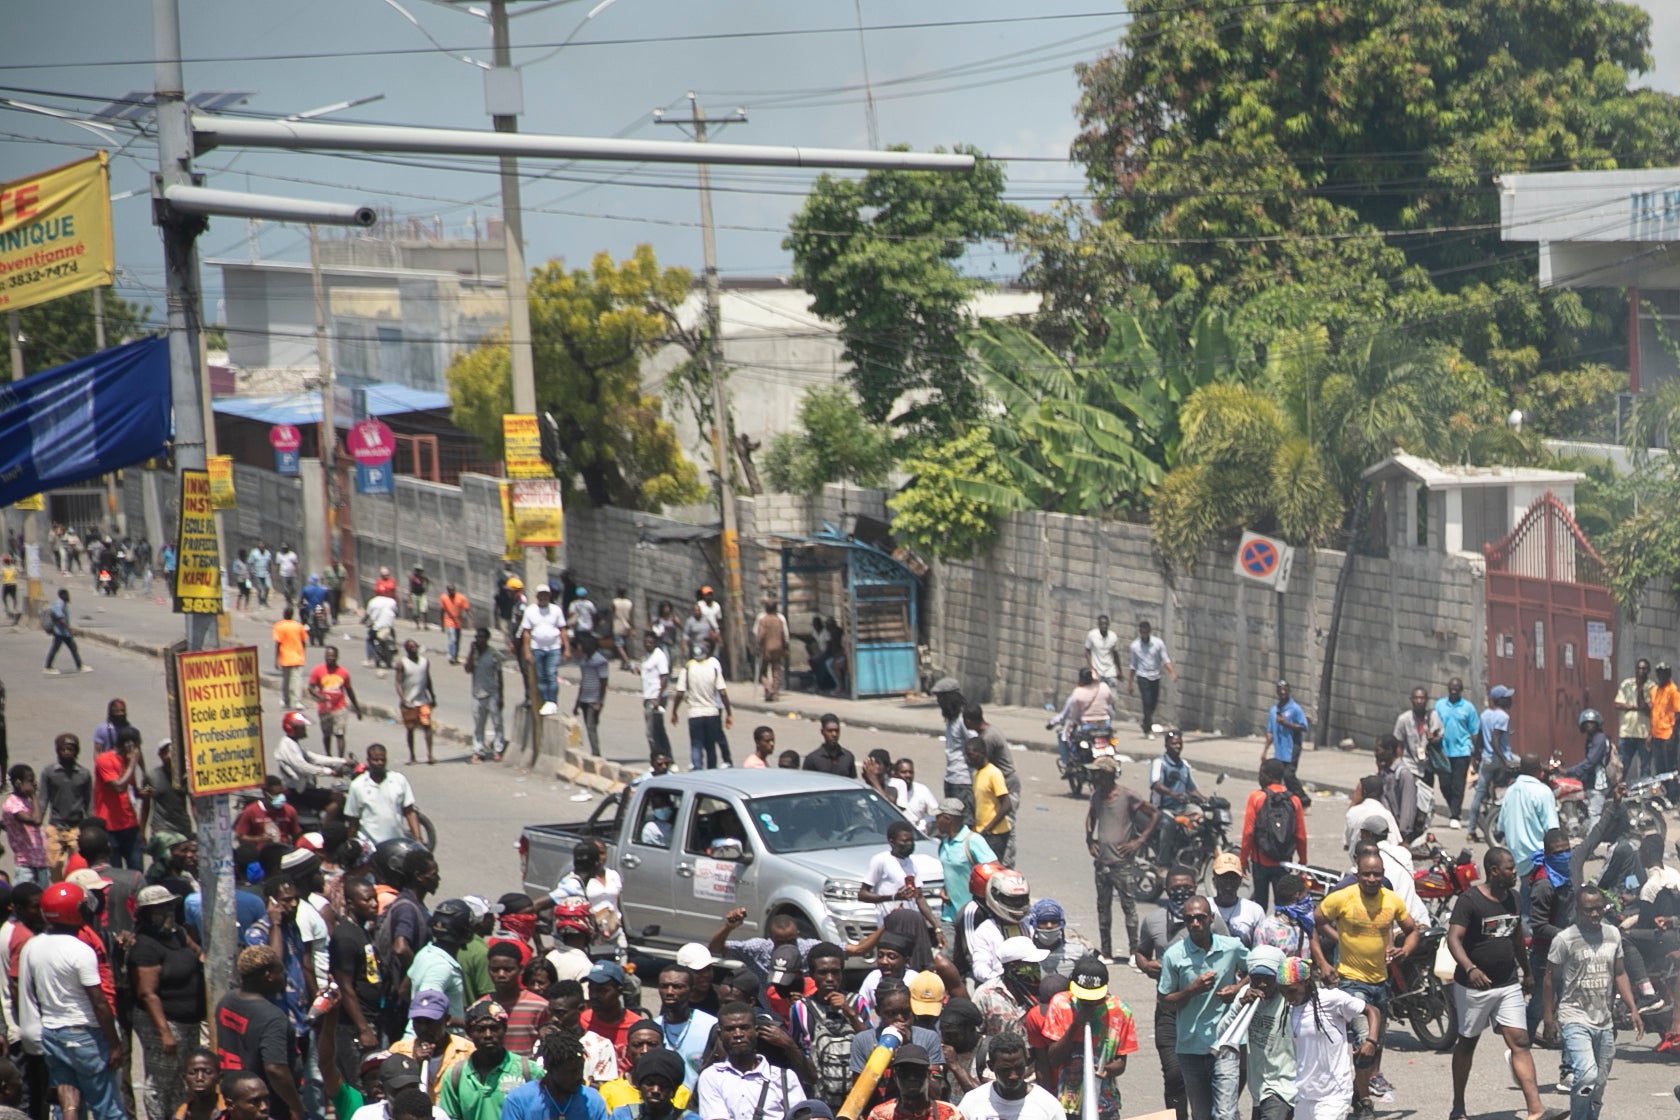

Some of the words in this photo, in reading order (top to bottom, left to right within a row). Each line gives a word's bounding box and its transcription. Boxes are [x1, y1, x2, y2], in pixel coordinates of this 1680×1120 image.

[185, 656, 253, 681] INNOVATION
[188, 680, 256, 702] INSTITUTE
[190, 707, 216, 724] Ecole
[219, 704, 230, 721] de
